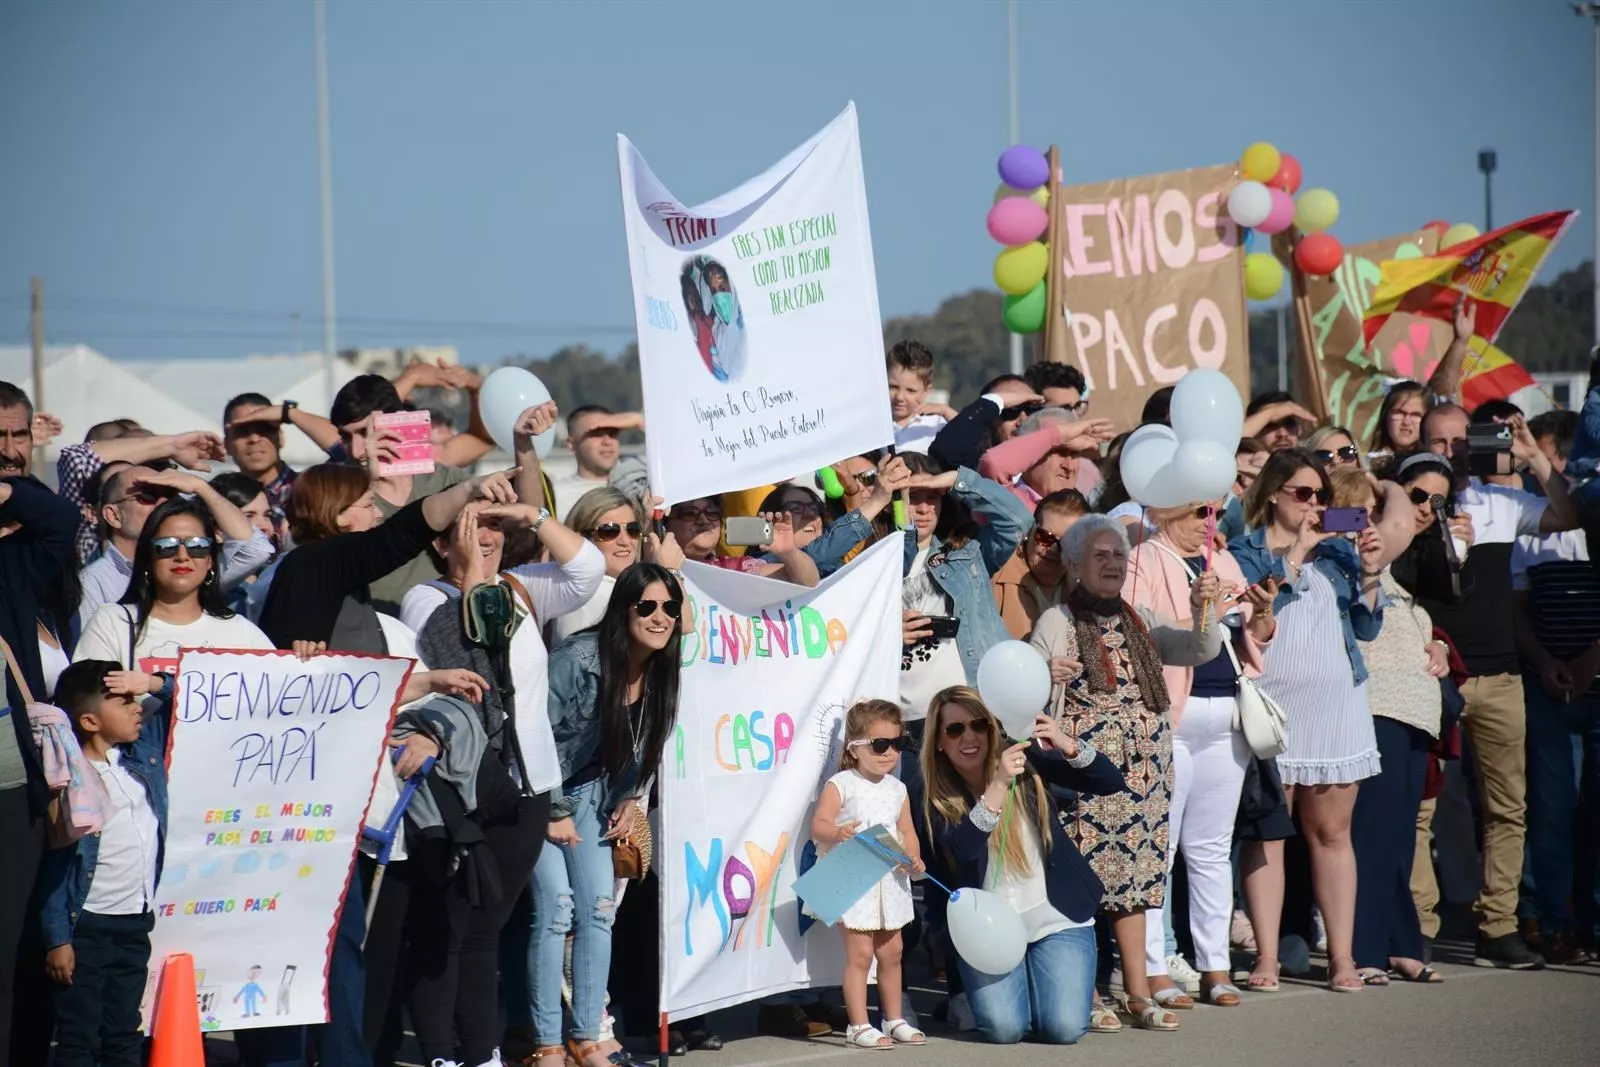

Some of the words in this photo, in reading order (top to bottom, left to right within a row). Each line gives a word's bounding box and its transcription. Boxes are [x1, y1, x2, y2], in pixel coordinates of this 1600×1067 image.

[731, 231, 761, 260] ERES
[764, 225, 786, 251] TAN
[789, 212, 838, 244] ESPECIAL
[1063, 189, 1238, 279] EMOS
[752, 261, 778, 287] COMO
[781, 255, 794, 279] TU
[769, 280, 825, 316] REALIZADA
[1068, 298, 1228, 390] PACO
[715, 436, 741, 461] Mejor
[743, 427, 758, 449] del
[759, 420, 788, 443] Puerto
[176, 671, 381, 723] BIENVENIDO
[230, 721, 328, 788] PAPÁ
[714, 710, 795, 771] CASA
[204, 809, 241, 824] ERES
[255, 804, 271, 819] EL
[280, 802, 333, 817] MEJOR
[250, 830, 273, 844] DEL
[281, 828, 336, 842] MUNDO
[159, 903, 175, 917] TE
[184, 899, 235, 915] QUIERO
[244, 892, 282, 912] PAPÁ
